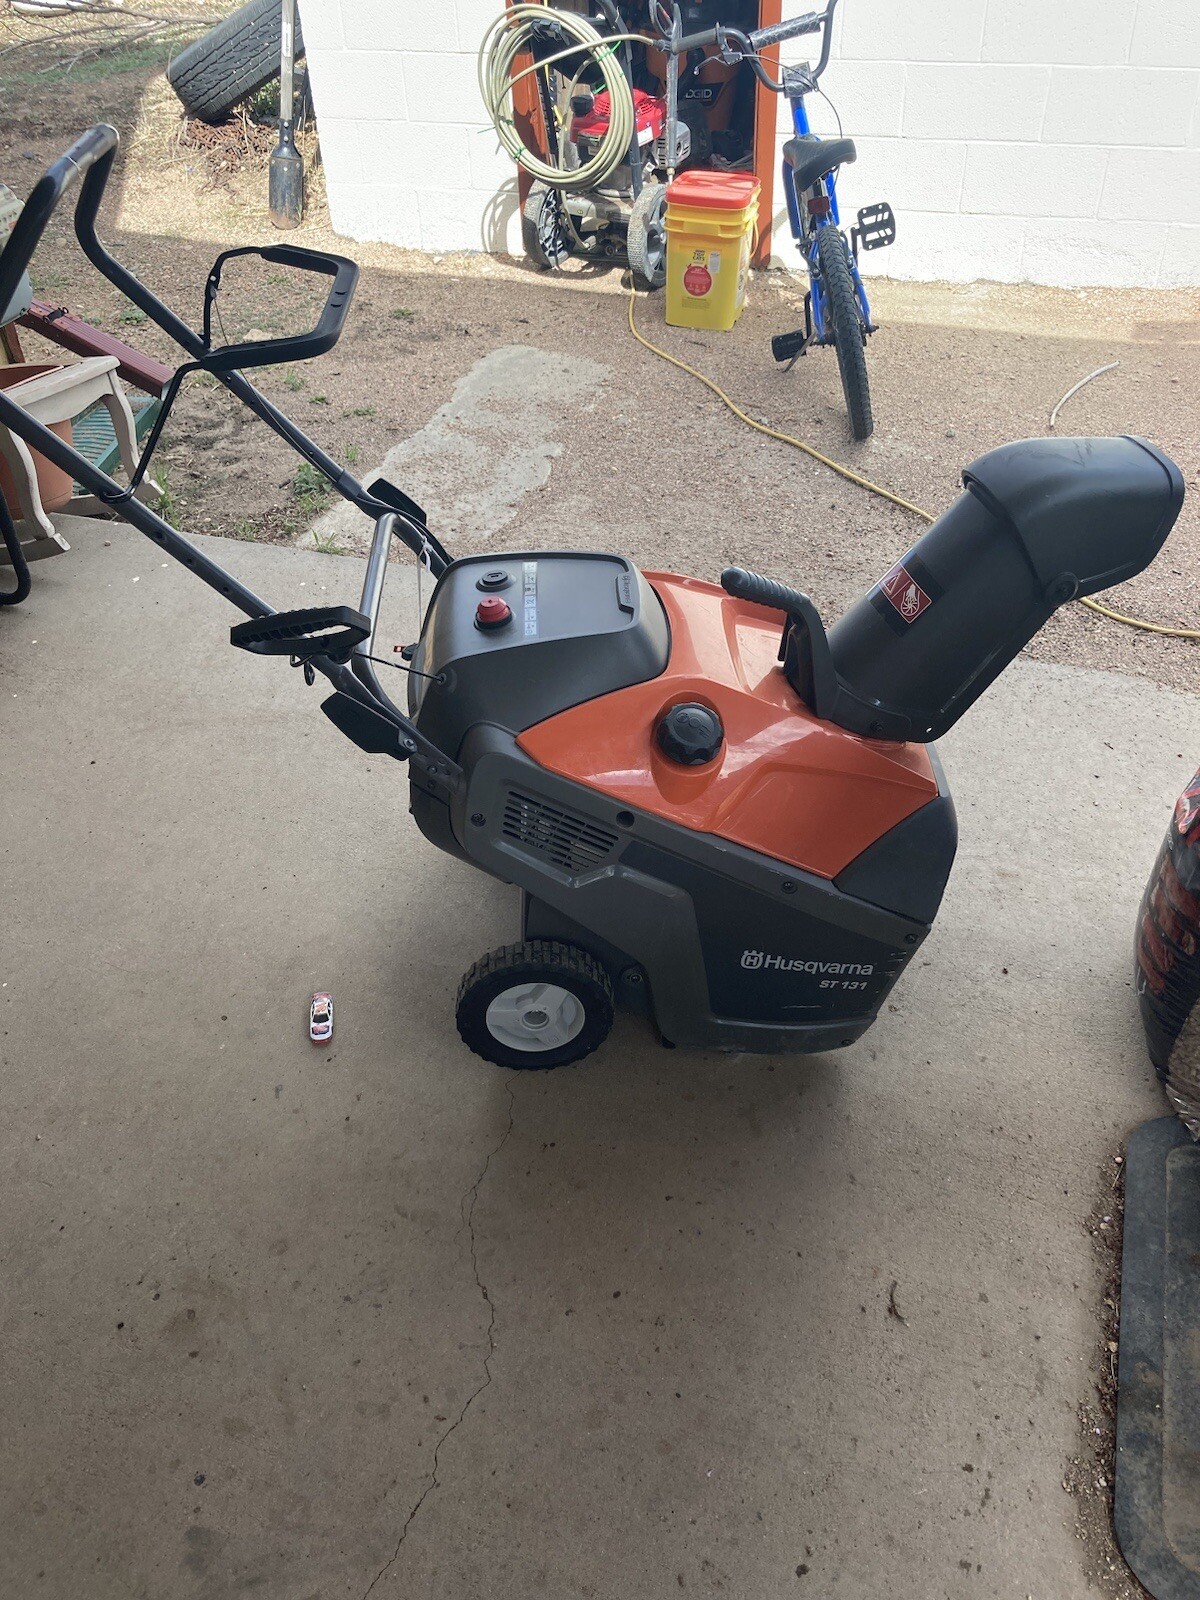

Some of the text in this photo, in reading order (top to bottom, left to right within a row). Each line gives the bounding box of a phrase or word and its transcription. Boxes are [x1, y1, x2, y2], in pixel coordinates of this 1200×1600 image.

[685, 88, 713, 99] DGID
[764, 954, 873, 975] Husqvarna
[819, 979, 868, 990] ST 131
